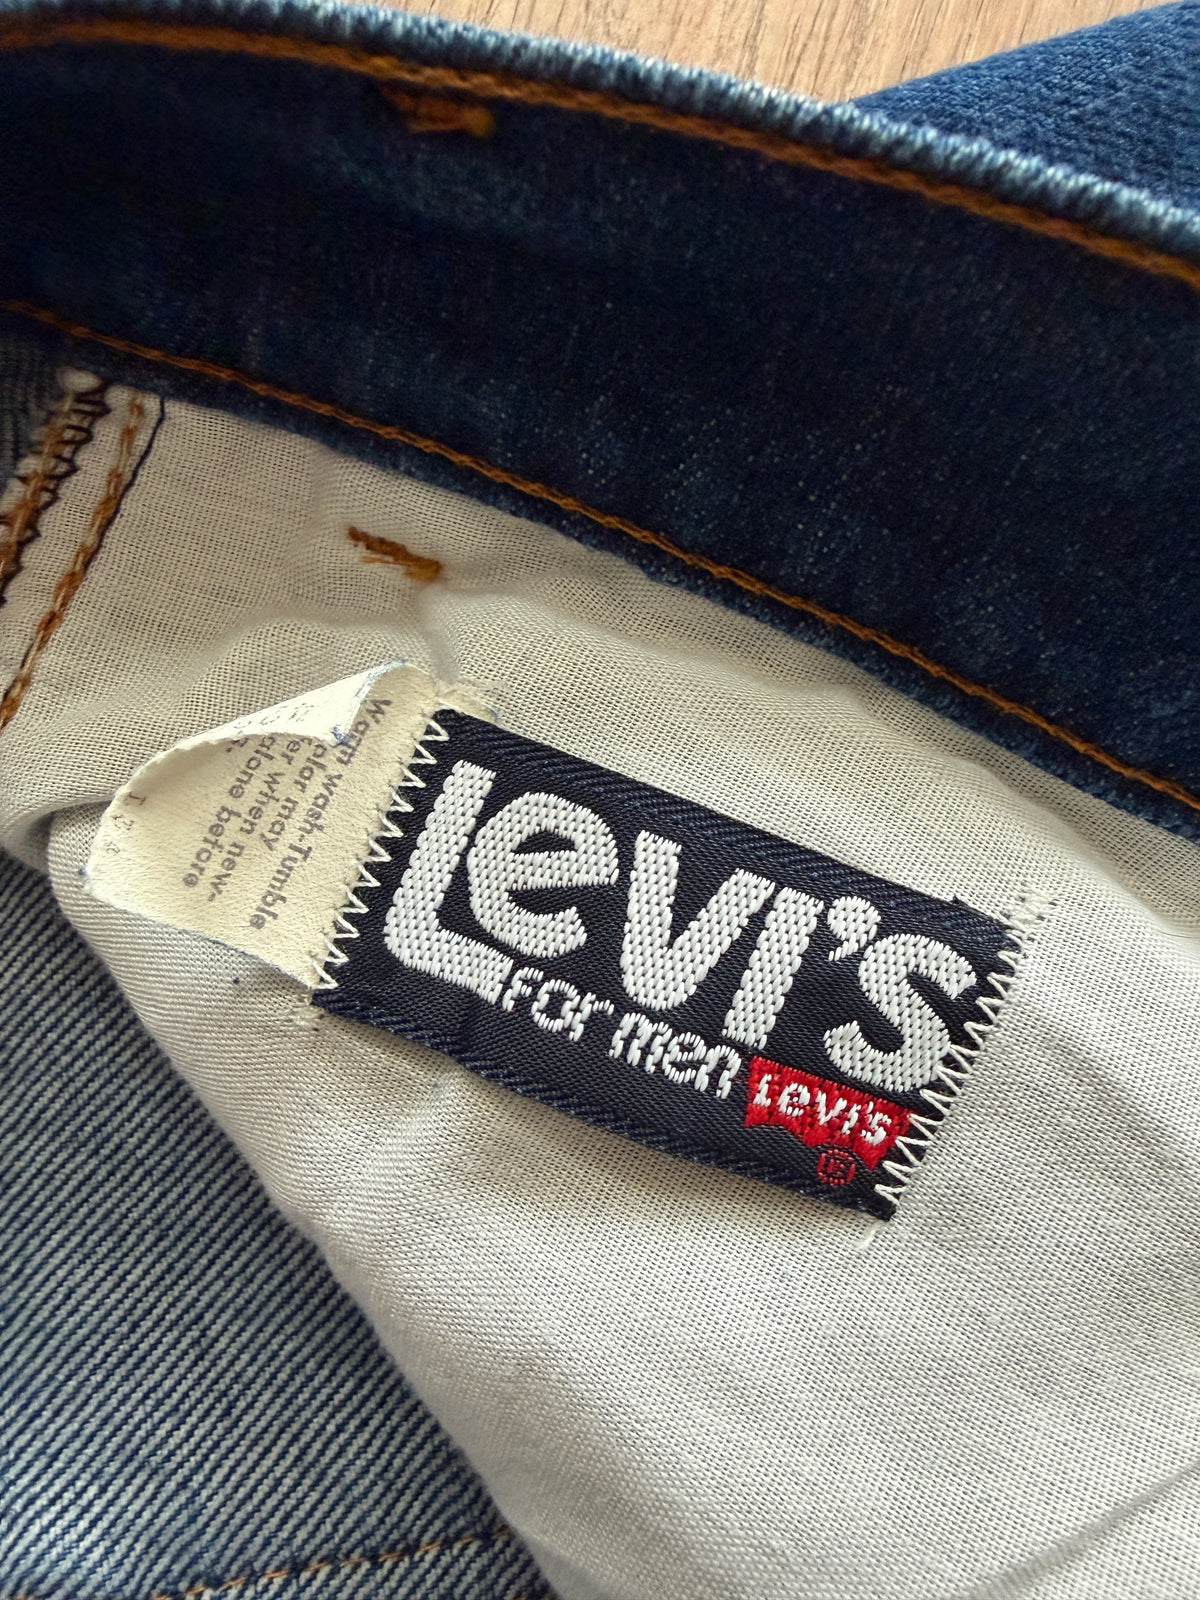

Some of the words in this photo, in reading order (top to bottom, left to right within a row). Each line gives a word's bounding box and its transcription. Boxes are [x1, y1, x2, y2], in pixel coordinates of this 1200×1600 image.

[228, 736, 276, 799] alone
[239, 772, 285, 834] when
[260, 797, 299, 851] may
[182, 806, 241, 888] before
[609, 1012, 742, 1099] men
